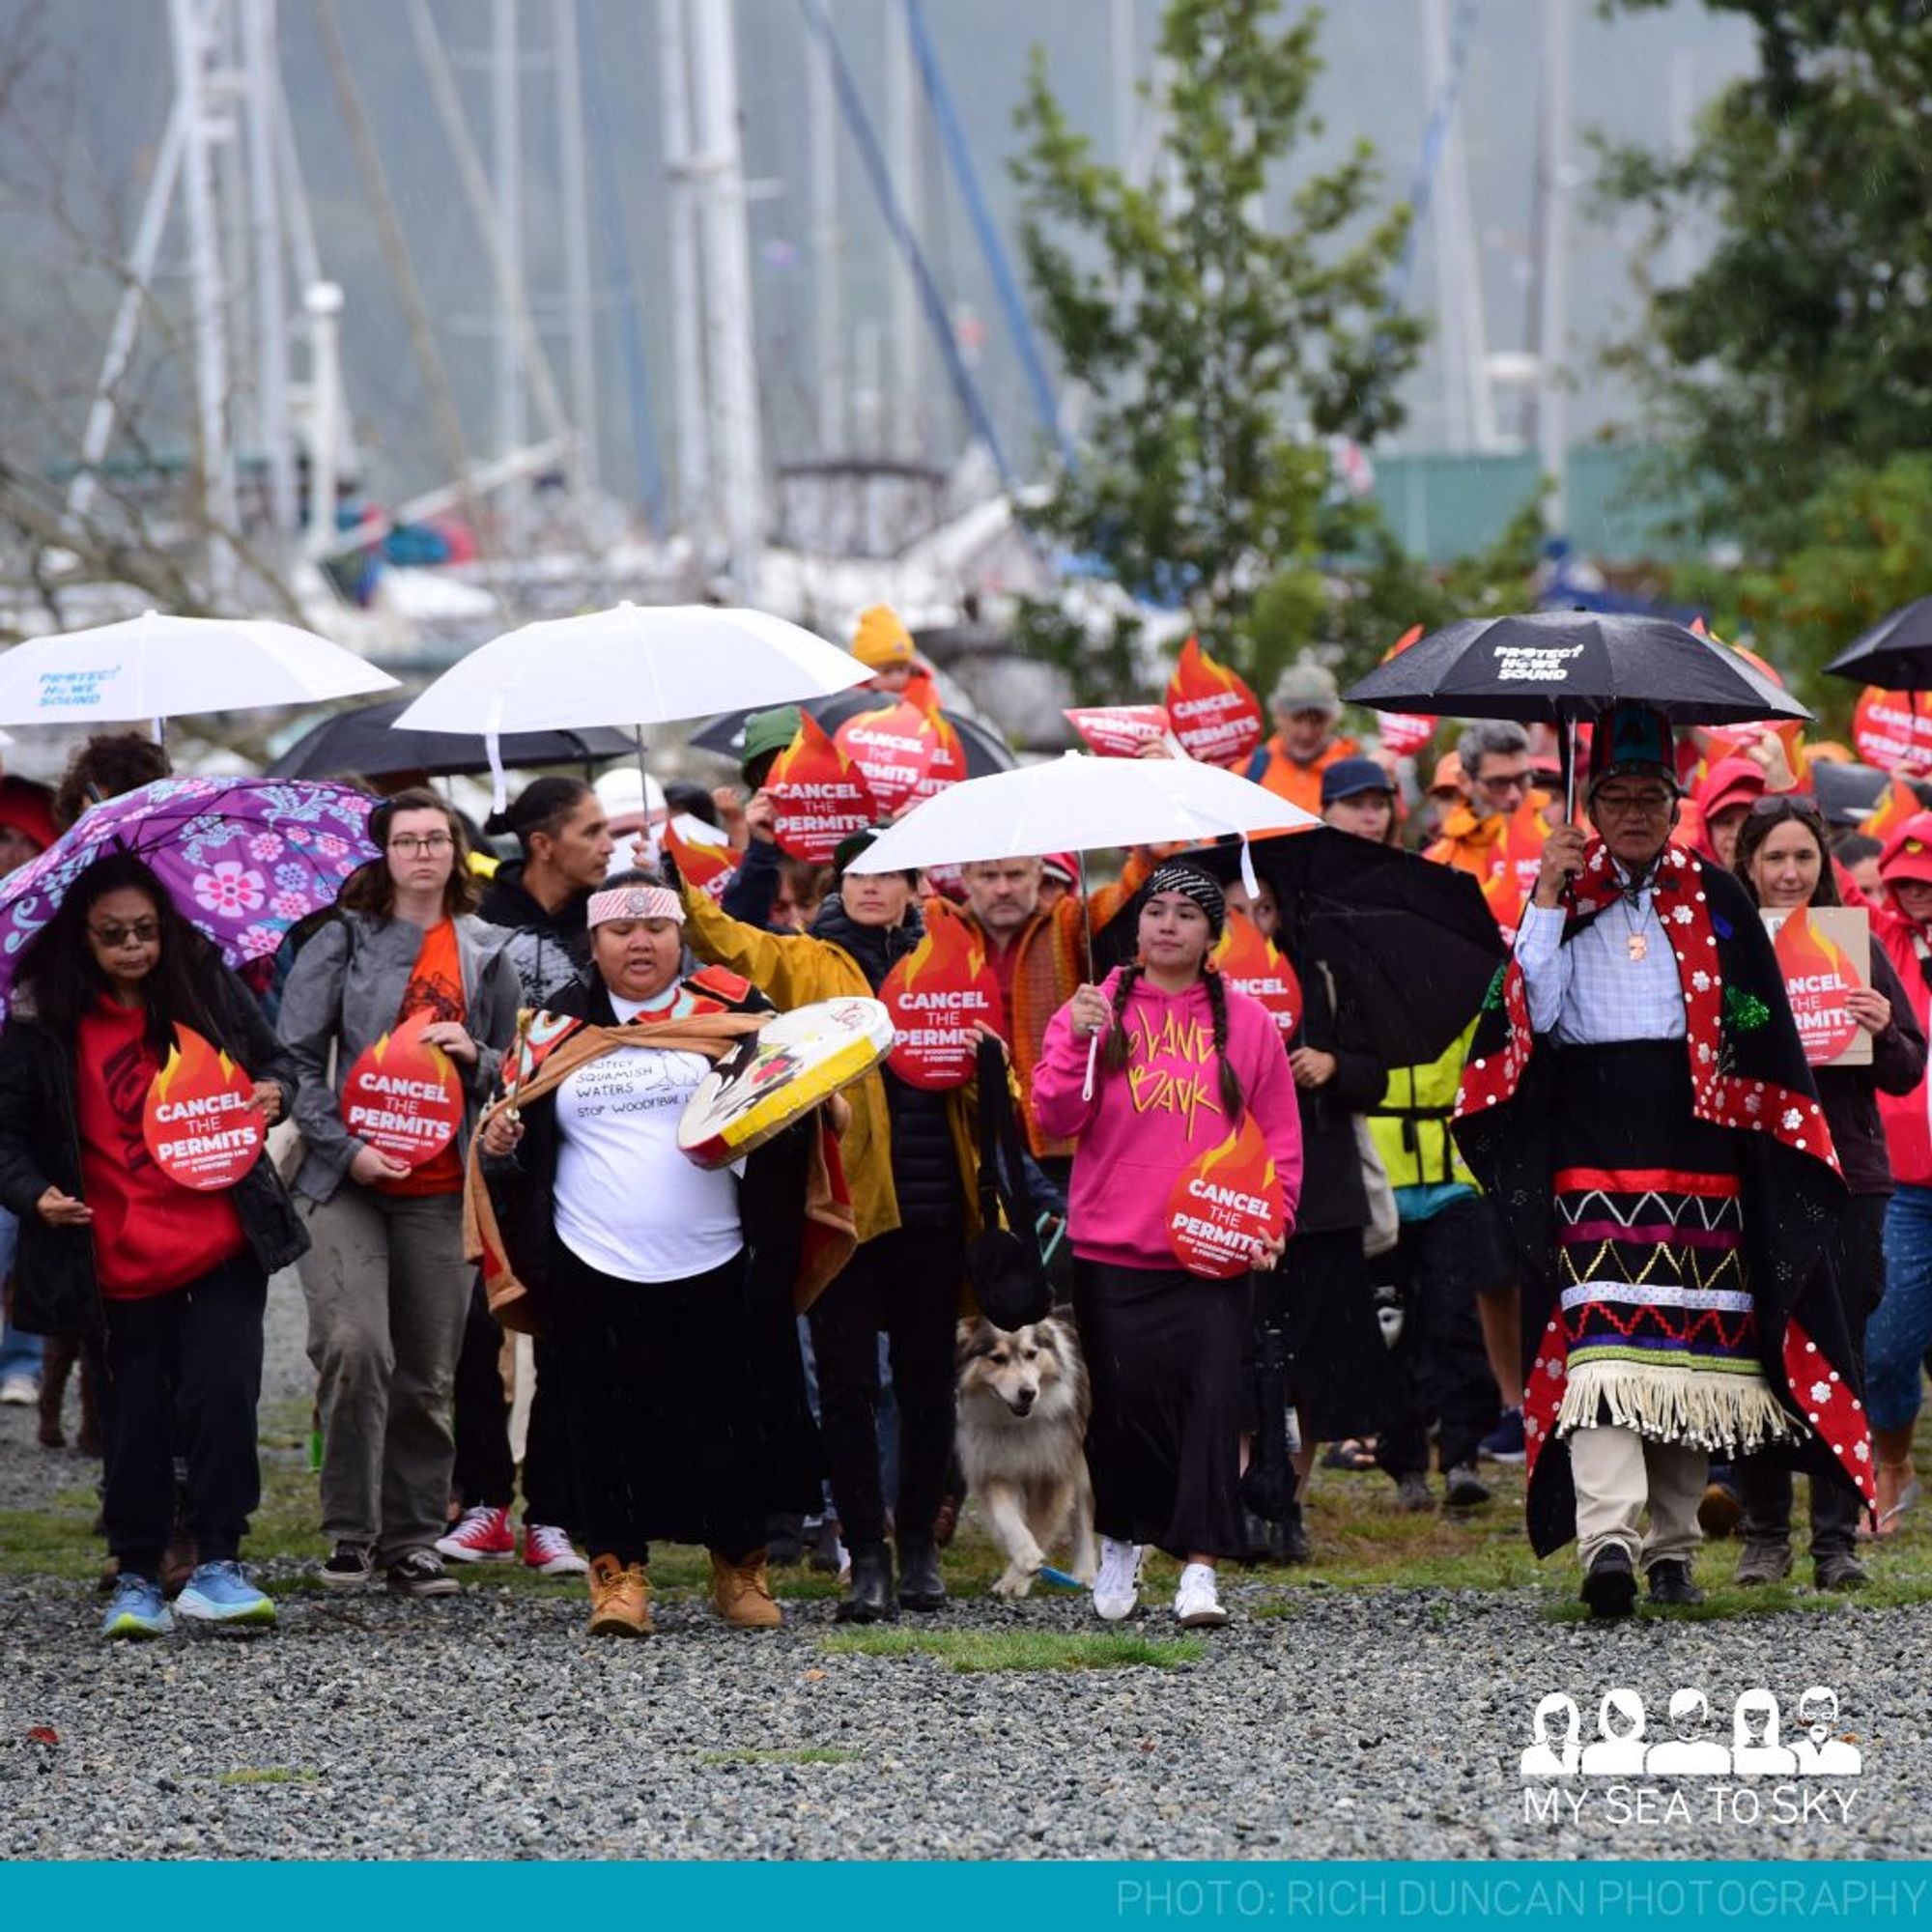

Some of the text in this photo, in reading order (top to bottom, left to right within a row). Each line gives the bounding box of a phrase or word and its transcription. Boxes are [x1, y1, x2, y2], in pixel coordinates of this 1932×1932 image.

[1493, 644, 1584, 659] PROTECT
[1497, 668, 1568, 681] SOUND
[1172, 692, 1245, 719] CANCEL
[847, 728, 923, 753] CANCEL
[1179, 716, 1261, 746] PERMITS
[775, 782, 864, 799] CANCEL
[803, 800, 838, 813] THE
[774, 814, 870, 834] PERMITS
[1231, 977, 1289, 996] NCEL
[898, 990, 990, 1010] CANCEL
[1789, 996, 1822, 1011] THE
[925, 1010, 960, 1027] THE
[893, 1028, 966, 1046] PERMI
[576, 1065, 653, 1084] SQUAMISH
[358, 1072, 450, 1104] CANCEL
[575, 1082, 635, 1098] WATERS
[156, 1092, 246, 1123] CANCEL
[384, 1095, 419, 1116] THE
[577, 1106, 606, 1119] STOP
[185, 1116, 223, 1134] THE
[349, 1105, 452, 1140] PERMITS
[157, 1126, 258, 1161] PERMITS
[1189, 1179, 1272, 1221] CANCEL
[1209, 1205, 1242, 1229] THE
